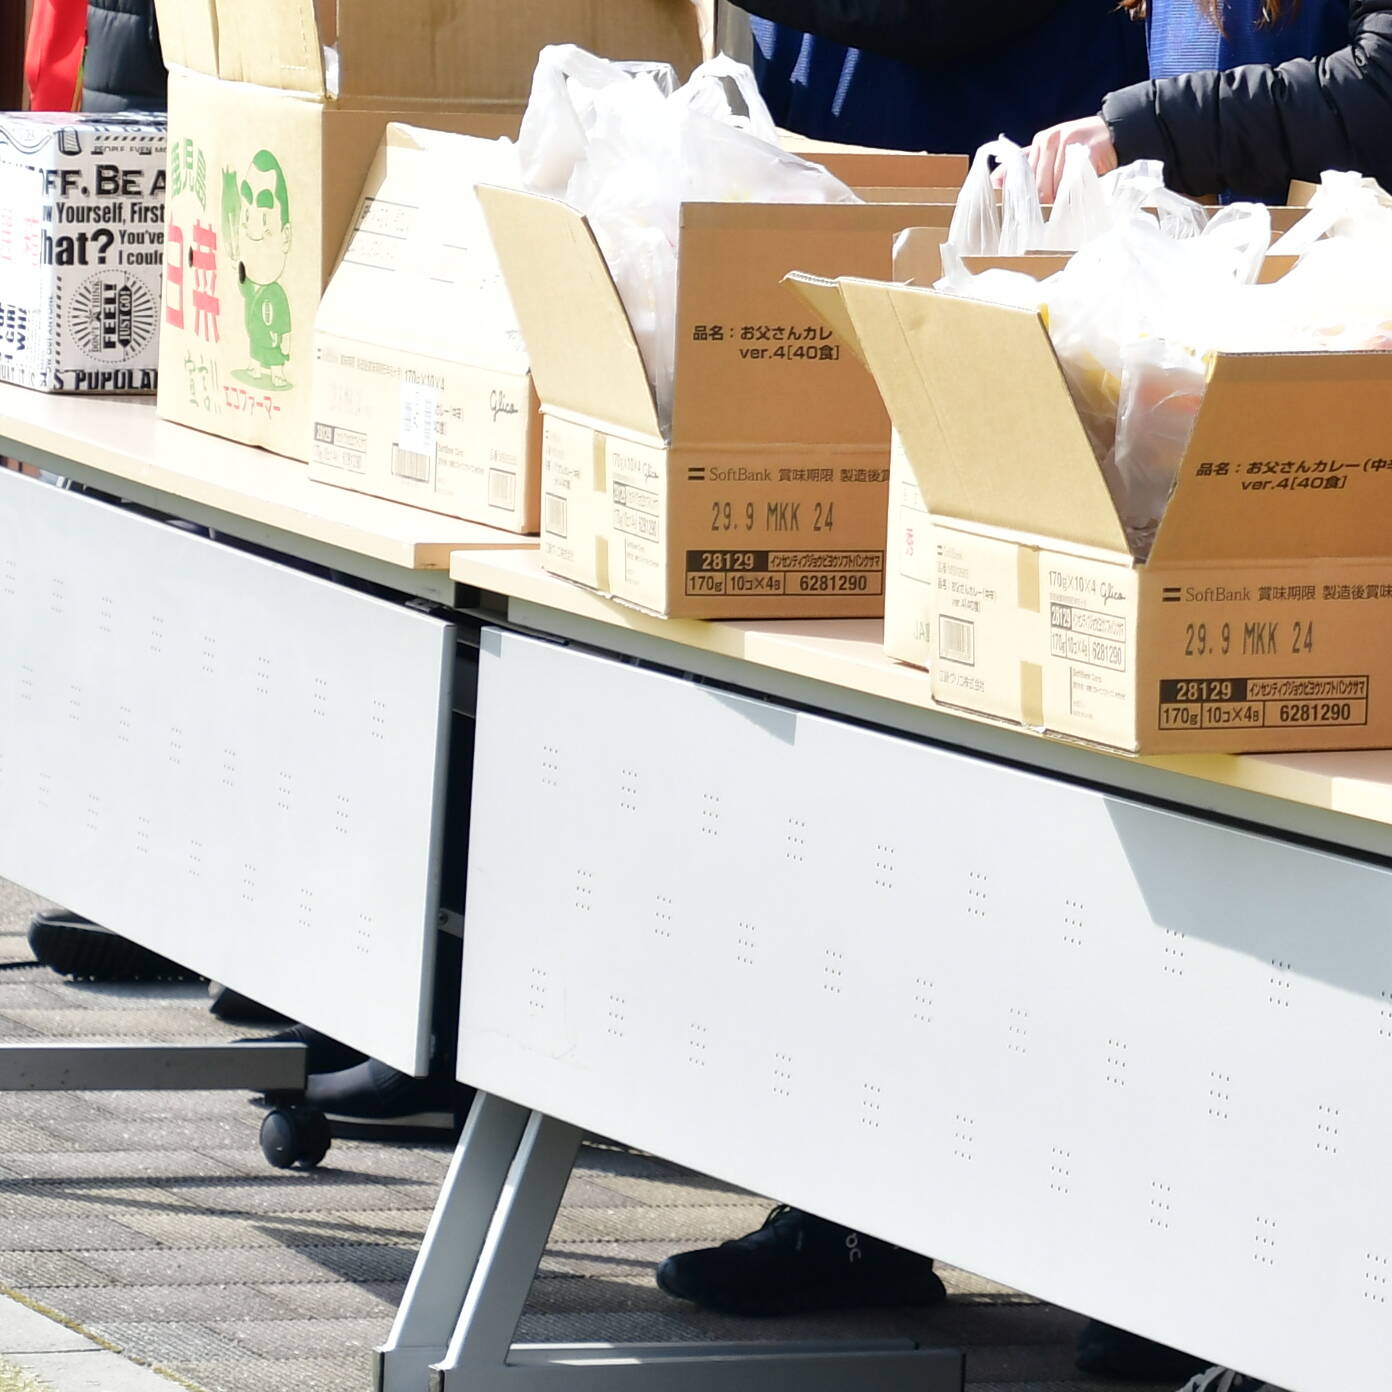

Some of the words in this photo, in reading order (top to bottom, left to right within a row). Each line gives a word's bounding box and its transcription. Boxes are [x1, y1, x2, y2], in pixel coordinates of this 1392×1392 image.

[96, 163, 143, 197] BE
[56, 202, 127, 226] Yourself,
[130, 202, 165, 224] First
[119, 229, 165, 245] You've
[119, 290, 132, 312] GO!
[103, 283, 117, 349] FEEL!
[119, 314, 132, 341] JUST
[489, 389, 519, 423] Glico
[709, 467, 772, 482] SoftBank
[778, 468, 834, 482] 賞味期限
[766, 501, 800, 532] MKK
[813, 501, 834, 532] 24
[701, 553, 755, 571] 28129
[689, 575, 723, 592] 170g
[799, 574, 867, 592] 6281290
[1185, 586, 1251, 603] SoftBank
[1258, 584, 1316, 601] 賞味期限
[1242, 621, 1278, 656] MKK
[1292, 620, 1314, 655] 24
[1176, 682, 1232, 701] 28129
[1163, 706, 1199, 726] 170g
[1279, 703, 1351, 722] 6281290
